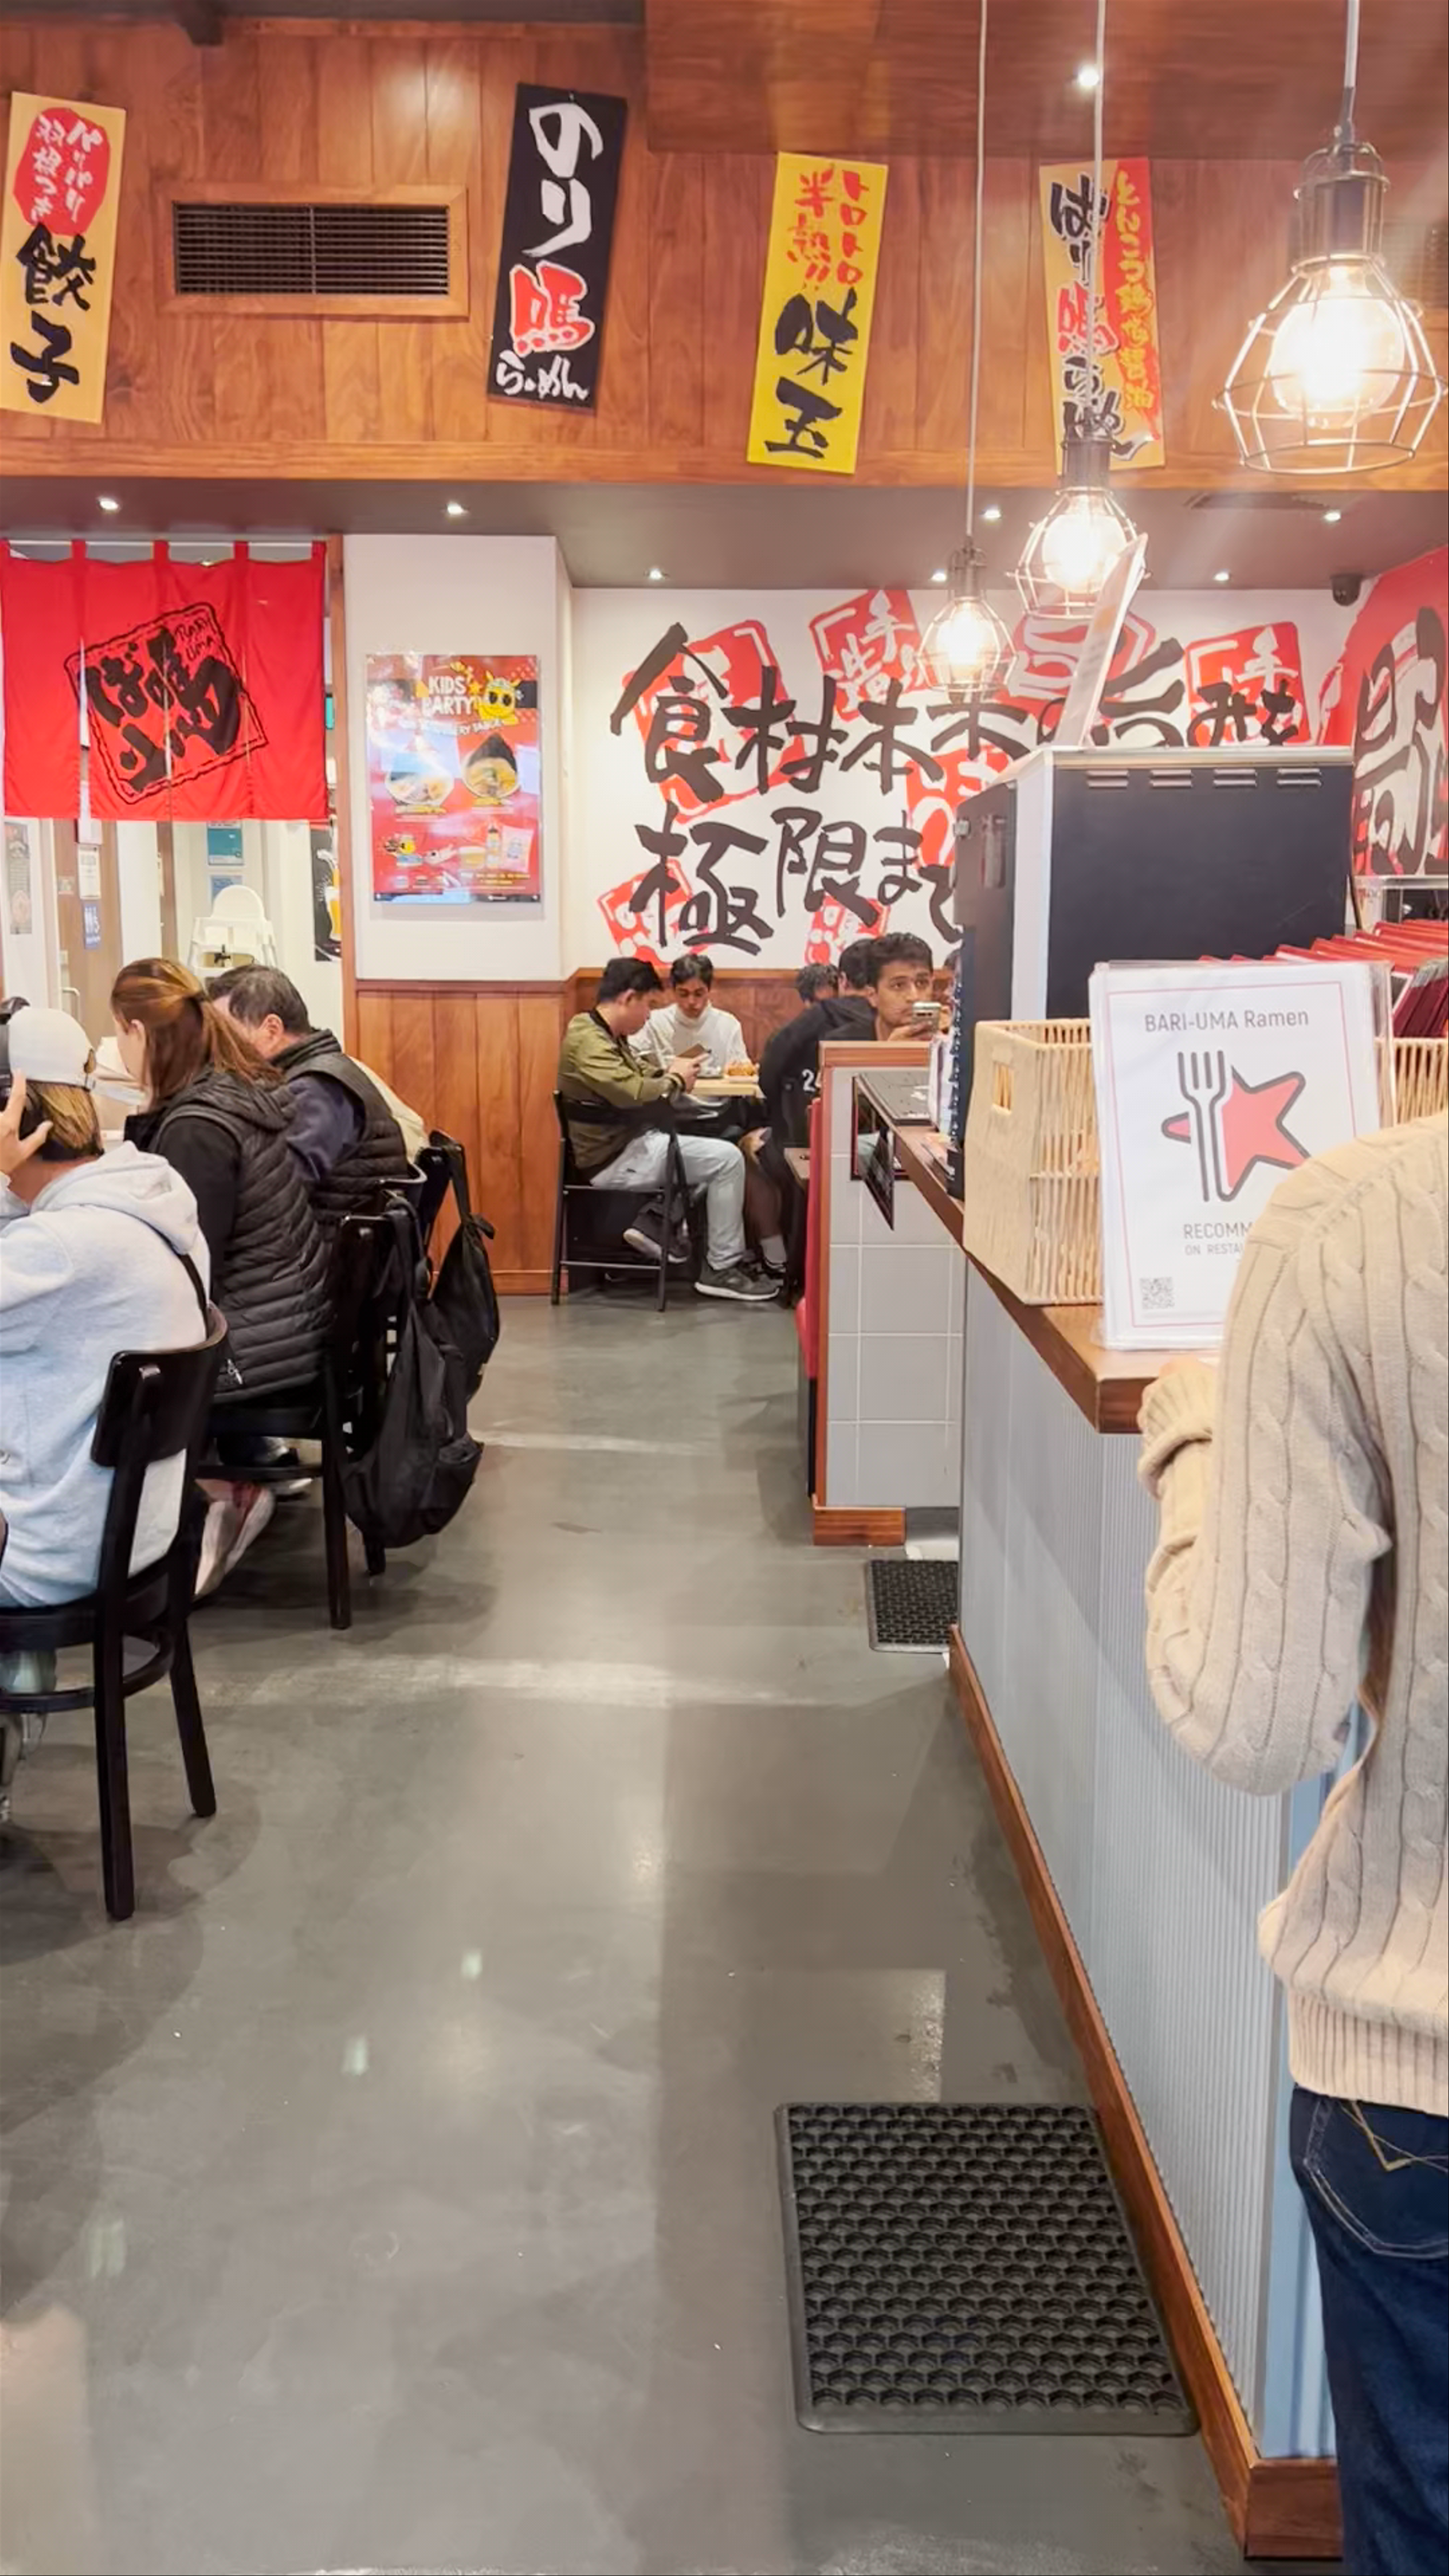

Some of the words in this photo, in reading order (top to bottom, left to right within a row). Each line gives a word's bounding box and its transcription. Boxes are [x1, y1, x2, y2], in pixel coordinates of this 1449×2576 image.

[10, 221, 96, 403] 餃子
[764, 287, 858, 458] 味玉
[428, 675, 467, 695] KIDS
[422, 696, 472, 715] PARTY
[1145, 1011, 1238, 1032] BARI-UMA
[1244, 1010, 1309, 1028] Ramen
[1185, 1245, 1200, 1256] ON
